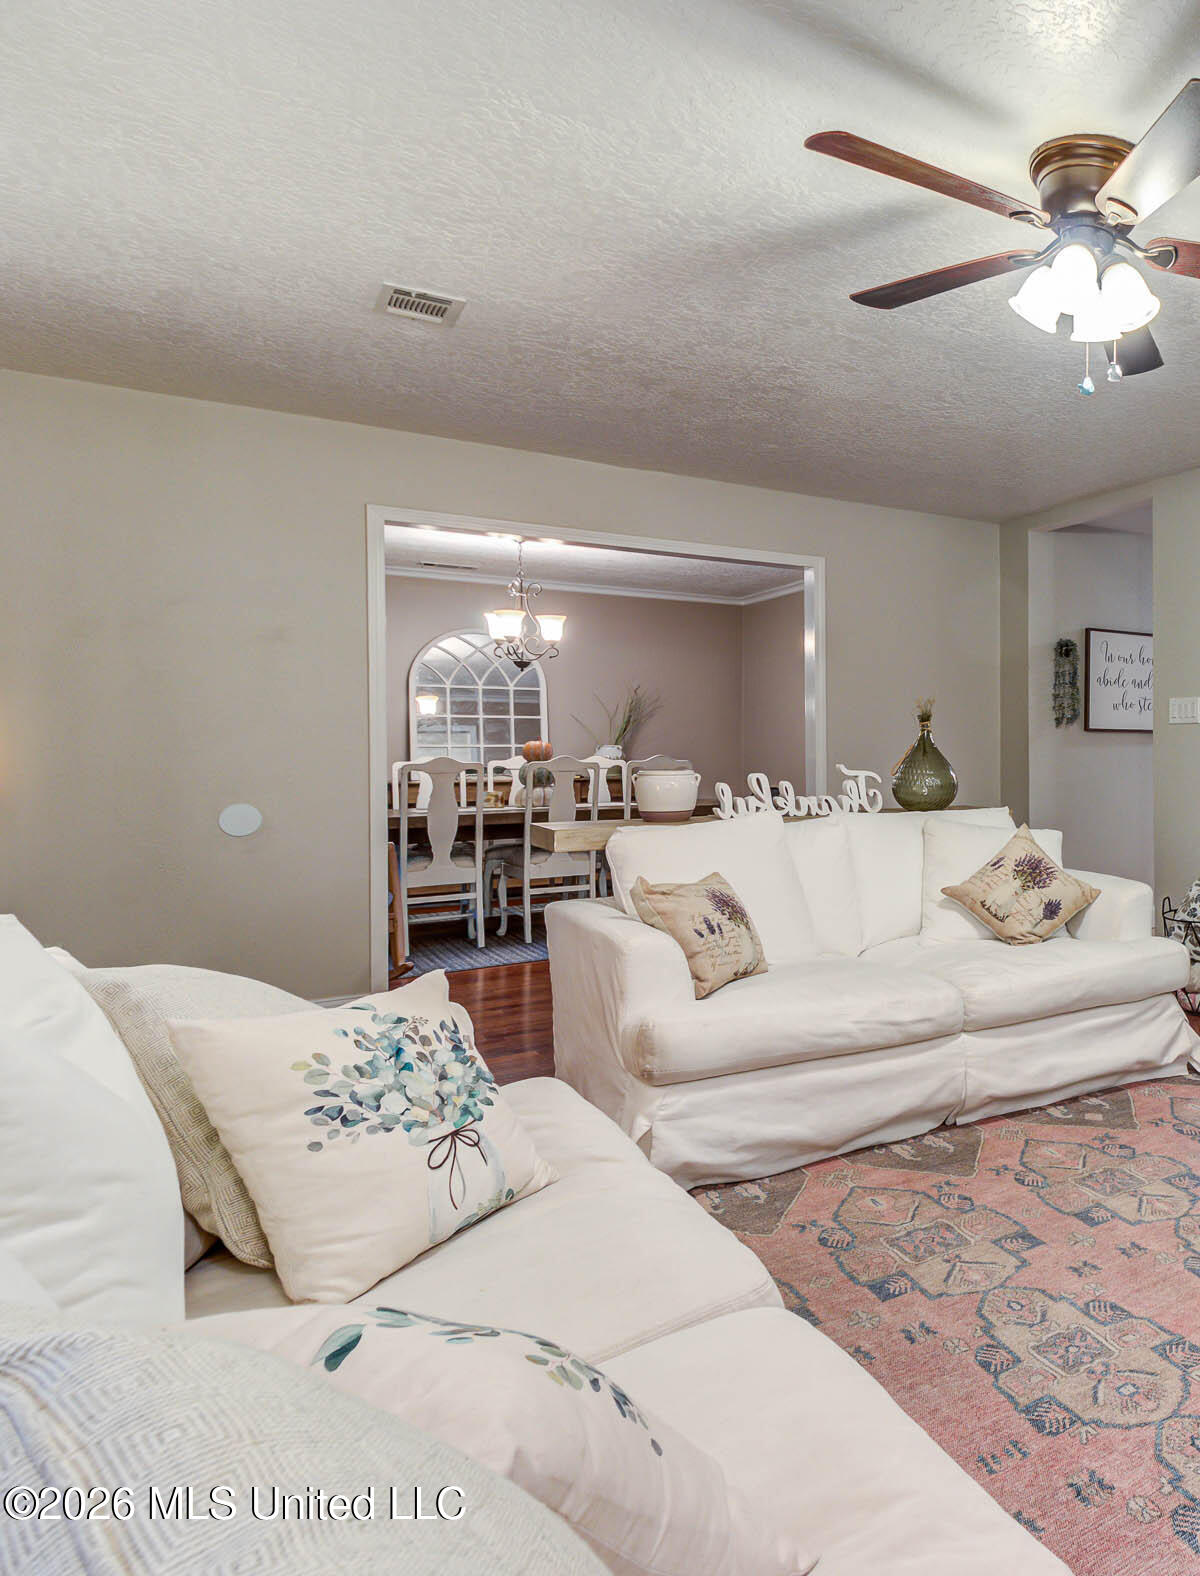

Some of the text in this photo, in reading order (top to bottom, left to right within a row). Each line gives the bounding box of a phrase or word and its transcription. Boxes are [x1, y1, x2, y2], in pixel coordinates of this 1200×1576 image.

[1098, 640, 1153, 665] In our ho
[1096, 667, 1153, 690] abide and
[1112, 690, 1136, 711] who
